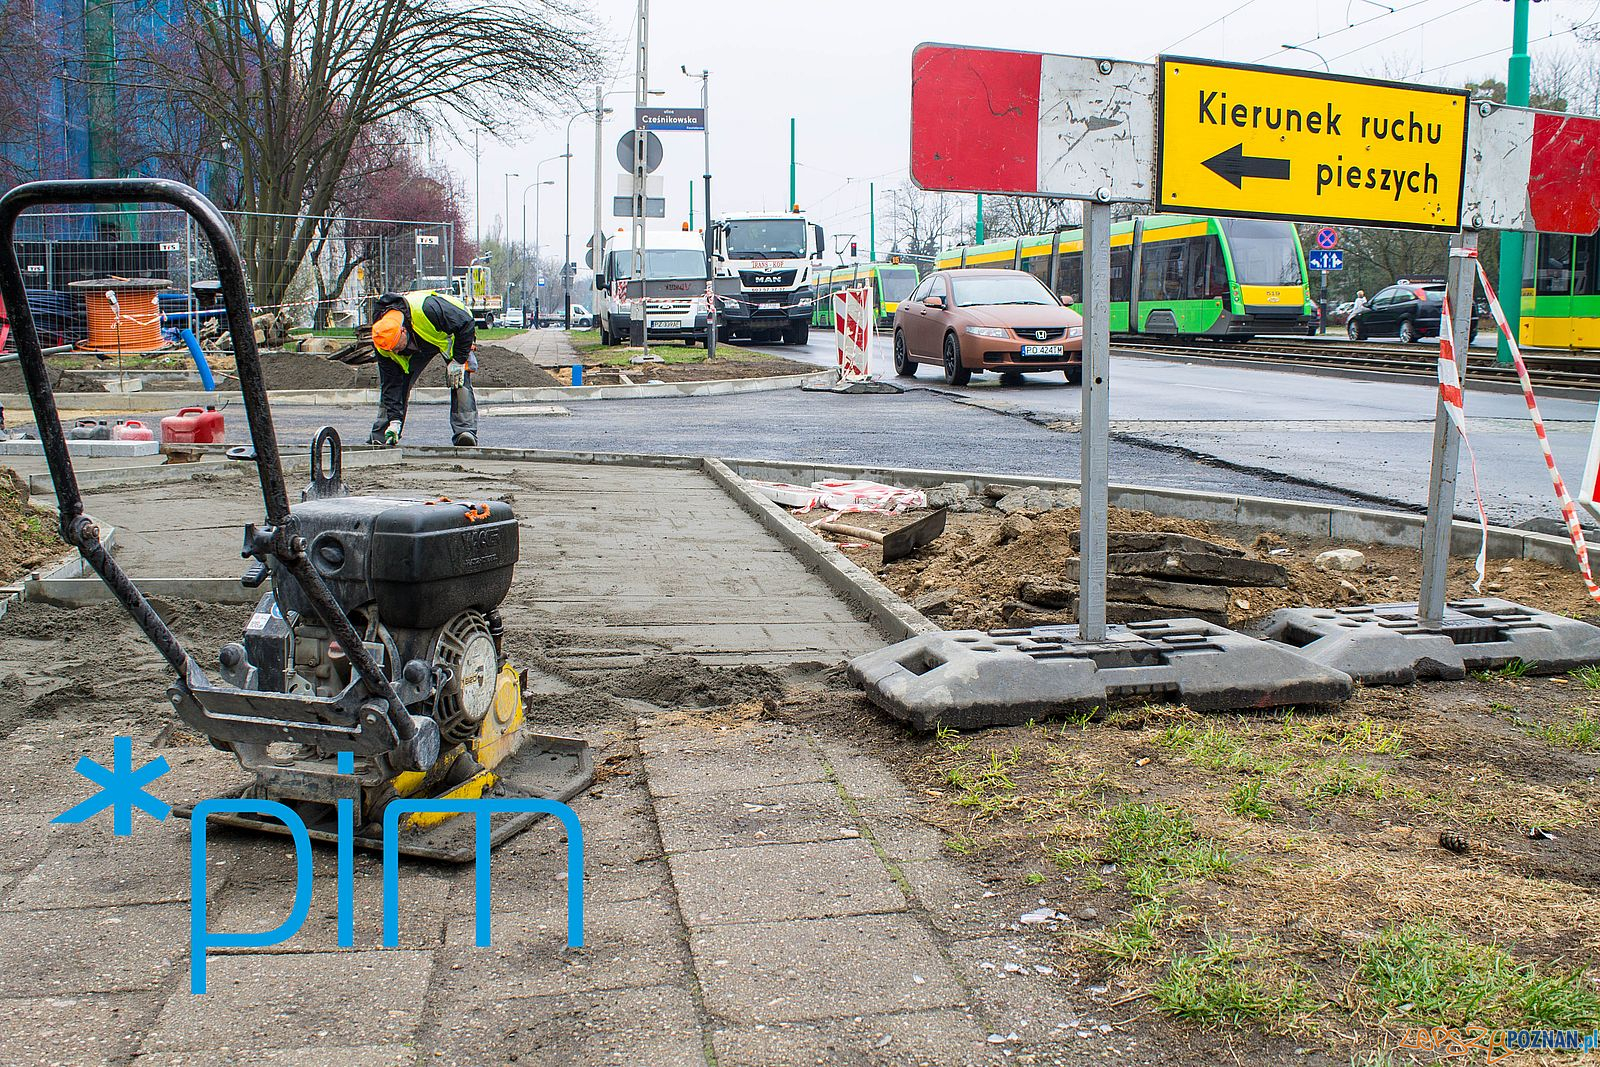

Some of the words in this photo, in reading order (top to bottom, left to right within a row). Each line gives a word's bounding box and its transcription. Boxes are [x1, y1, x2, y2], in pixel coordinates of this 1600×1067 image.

[1199, 90, 1341, 136] Kierunek
[1361, 111, 1442, 144] ruchu
[1316, 155, 1438, 201] pieszych
[1026, 346, 1037, 354] PO
